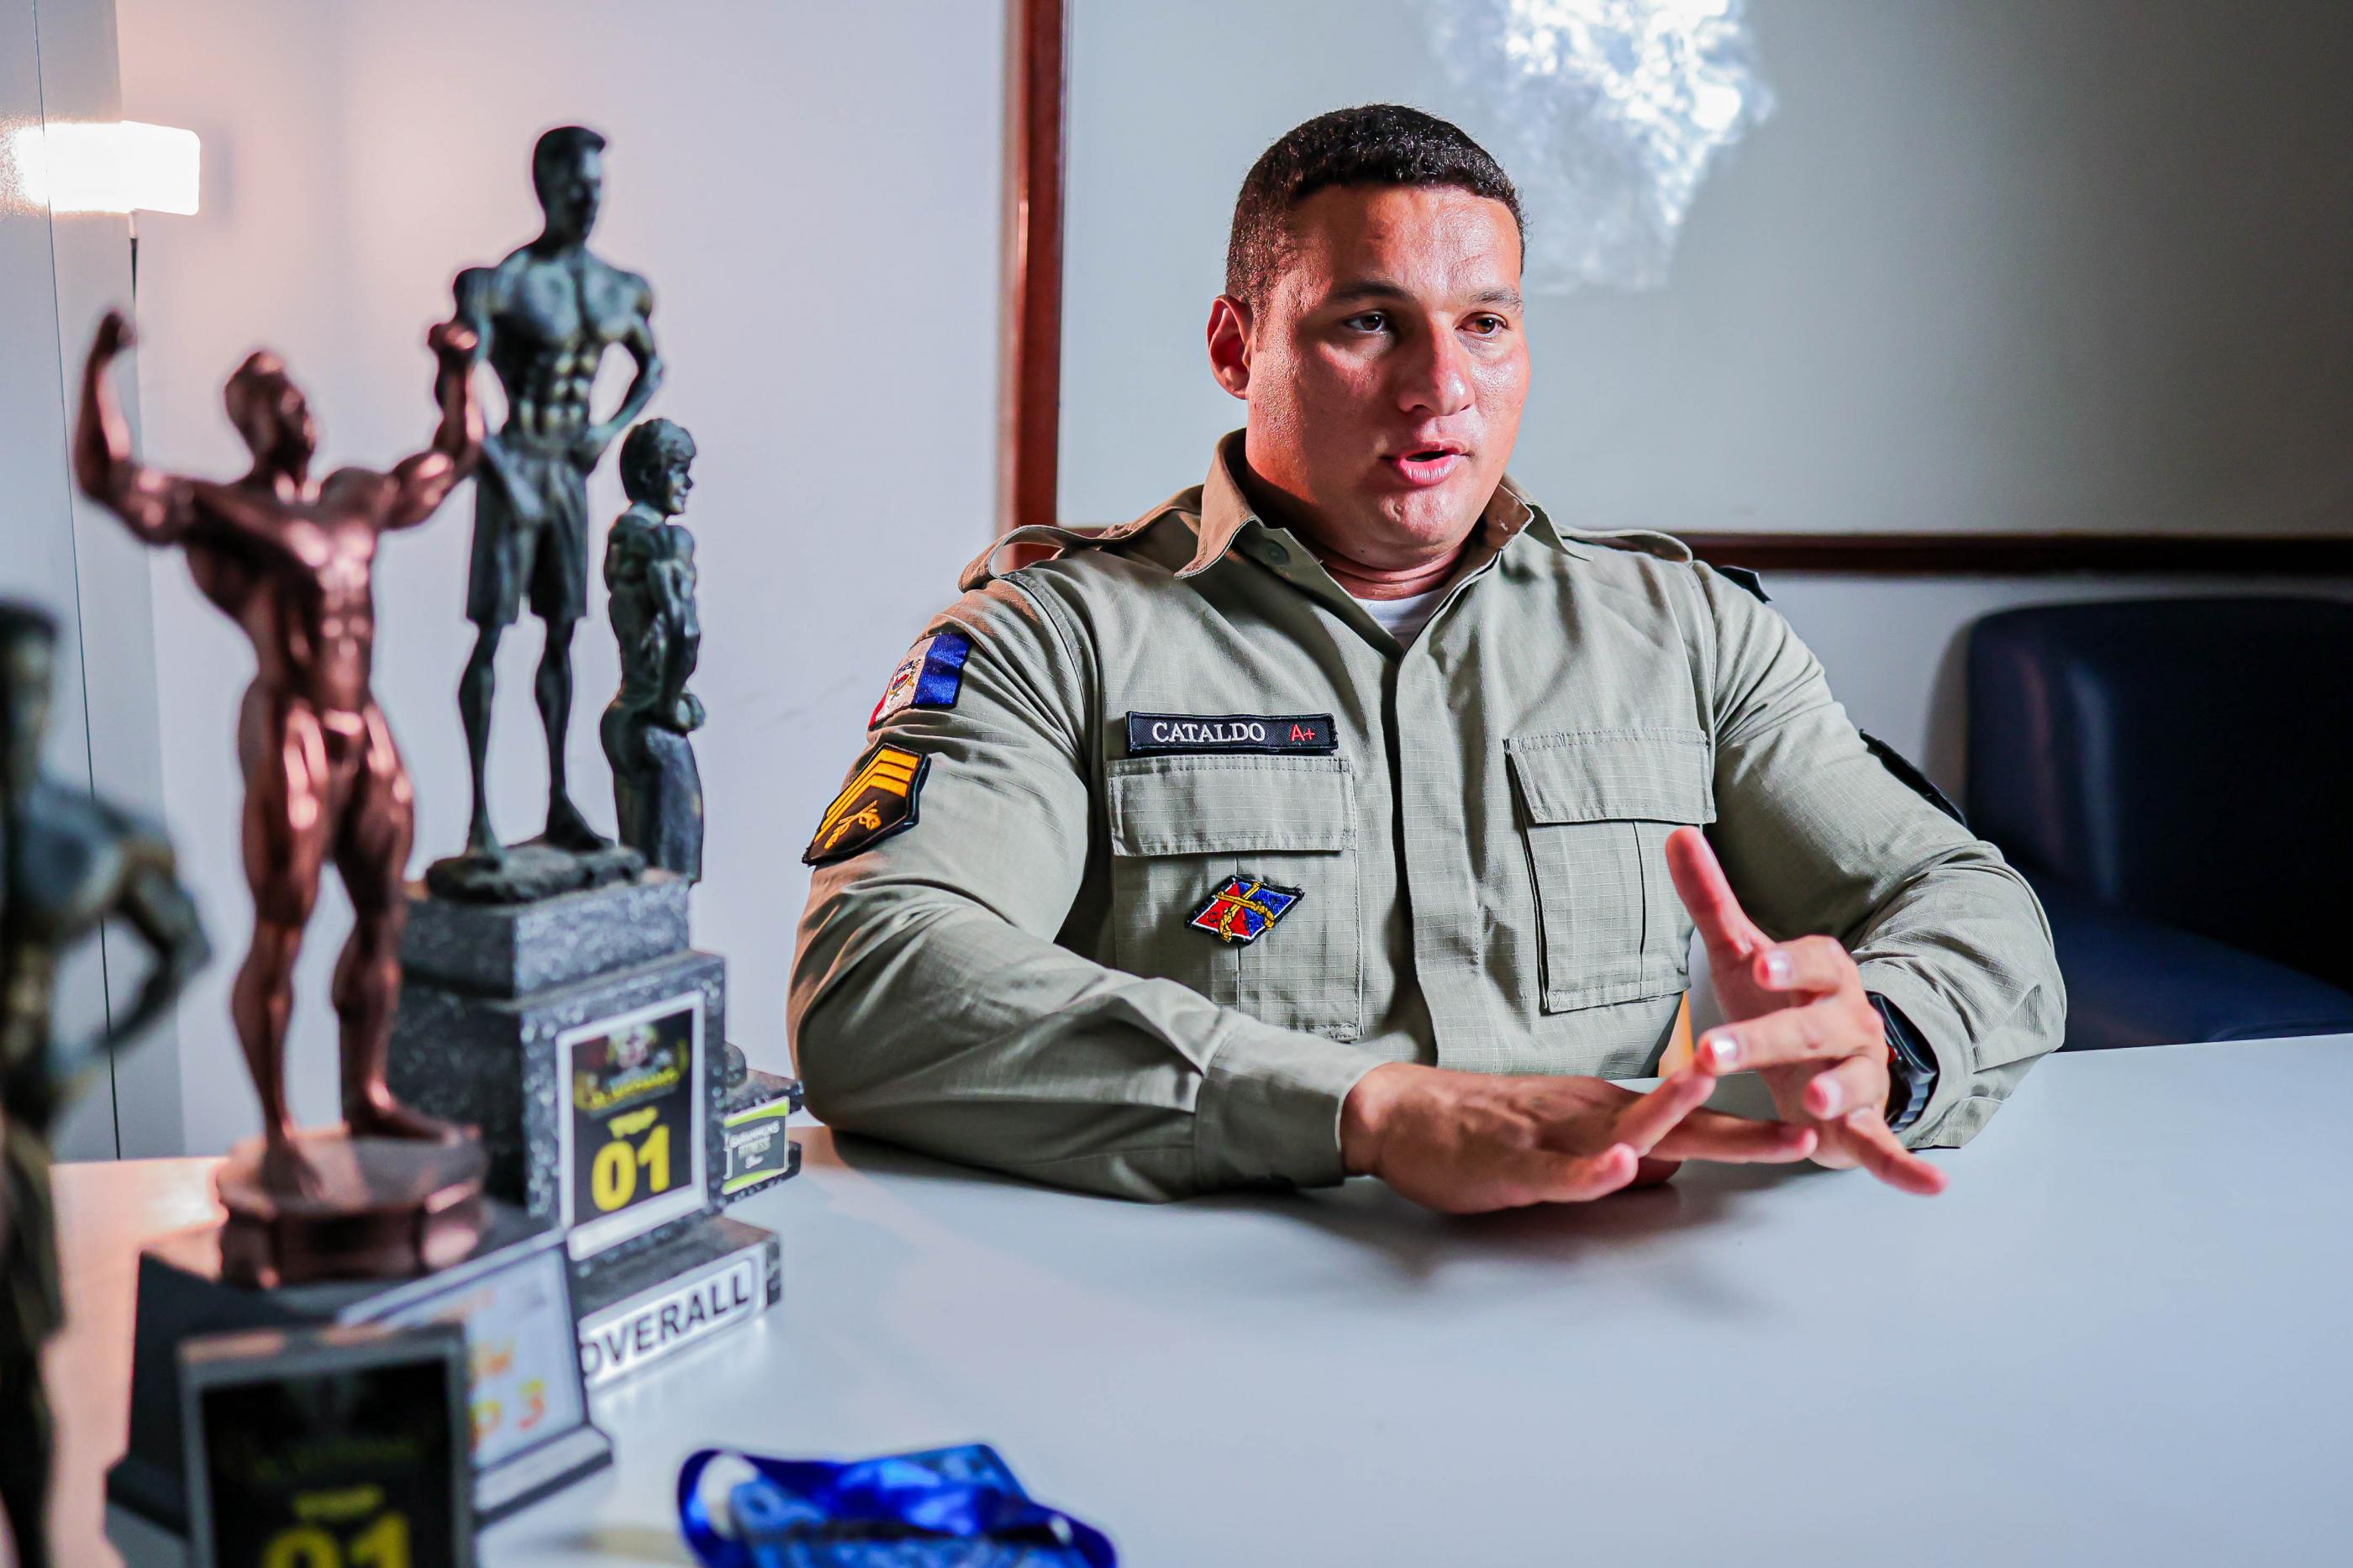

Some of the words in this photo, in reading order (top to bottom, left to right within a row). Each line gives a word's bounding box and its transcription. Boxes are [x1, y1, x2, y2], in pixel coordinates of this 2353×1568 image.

[1152, 722, 1266, 743] CATALDO
[1289, 723, 1315, 743] A+
[591, 1123, 671, 1213] 01
[581, 1272, 750, 1375] OVERALL
